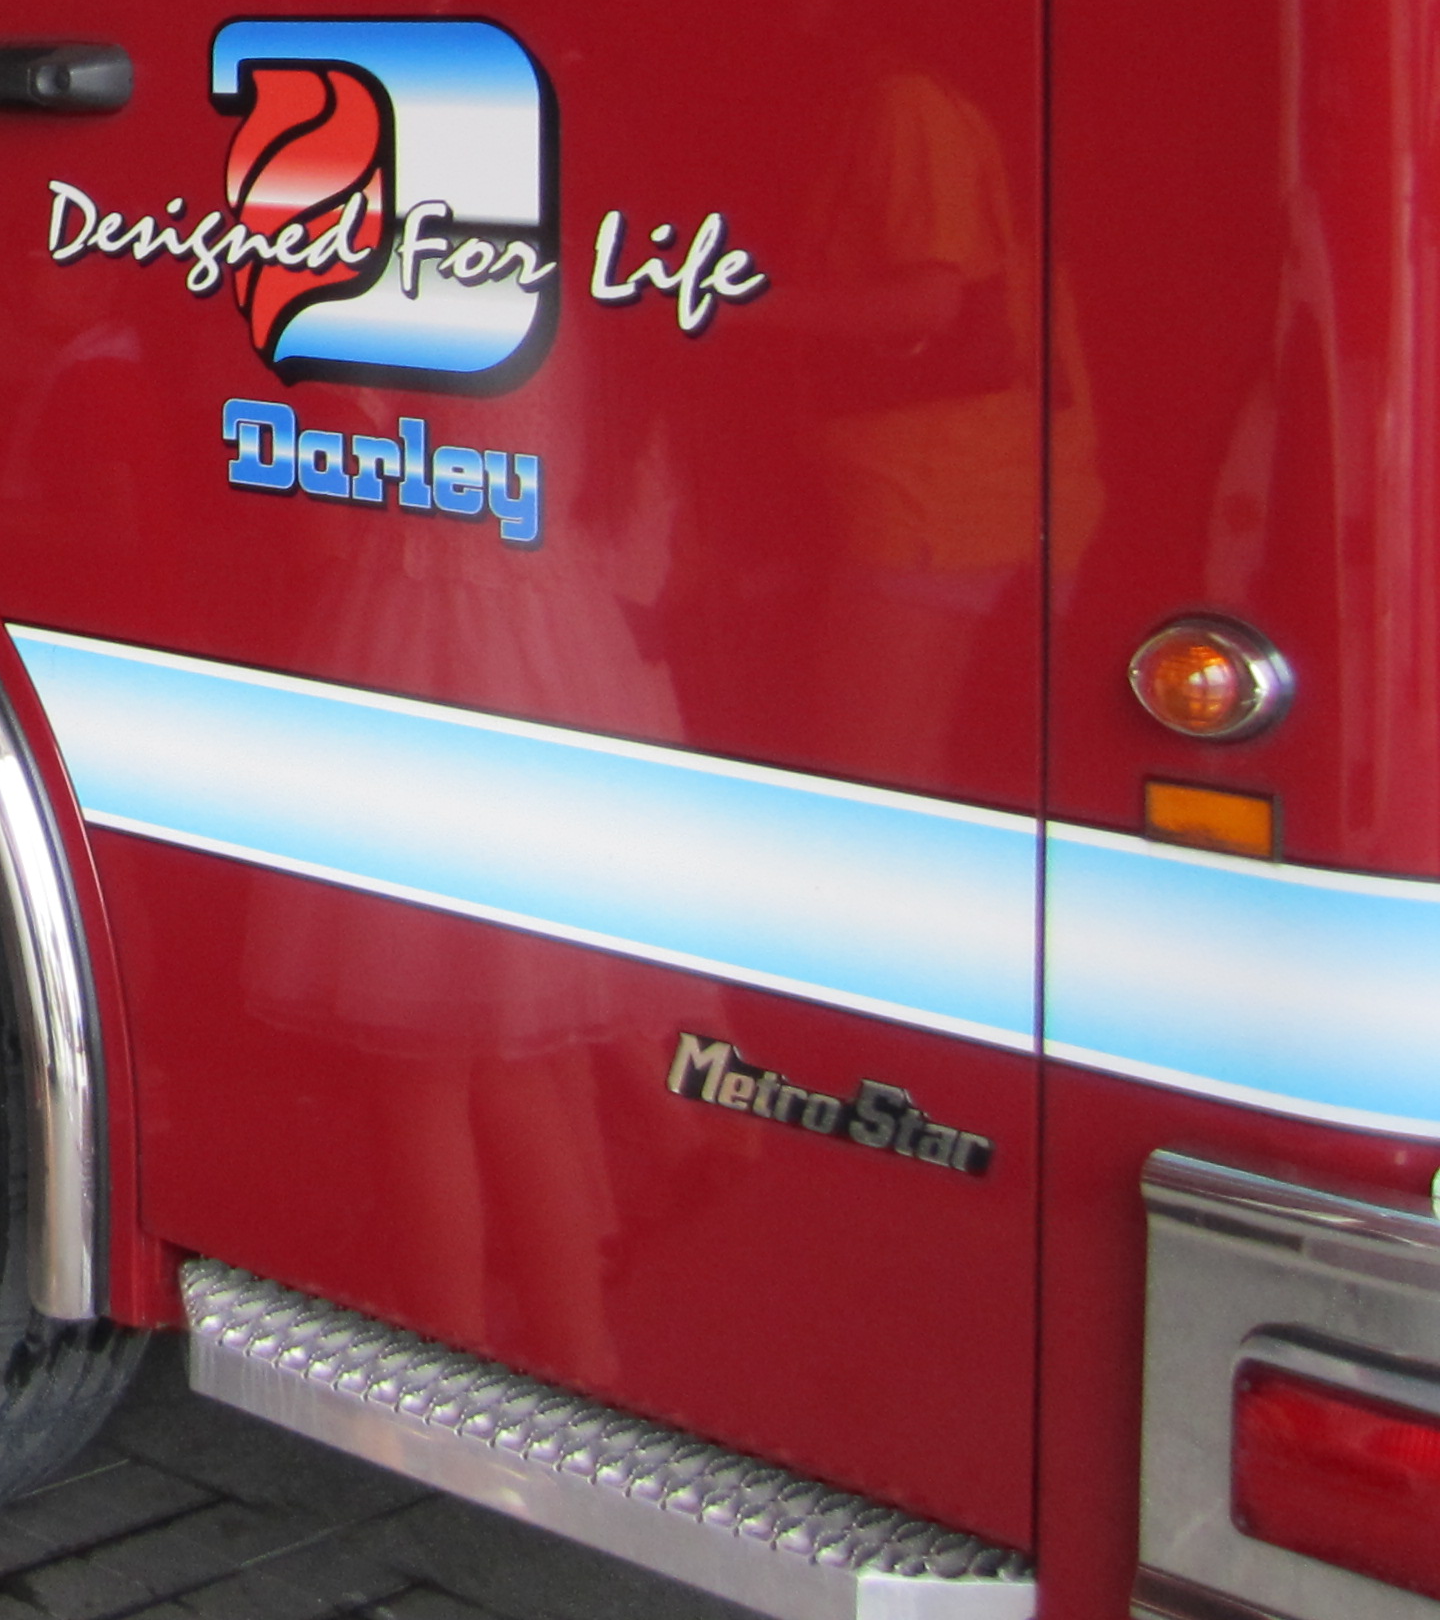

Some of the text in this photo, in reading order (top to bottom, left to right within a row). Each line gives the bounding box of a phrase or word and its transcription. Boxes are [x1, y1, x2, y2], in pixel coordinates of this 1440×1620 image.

[46, 179, 768, 336] Designed For Life
[222, 397, 543, 548] Darley
